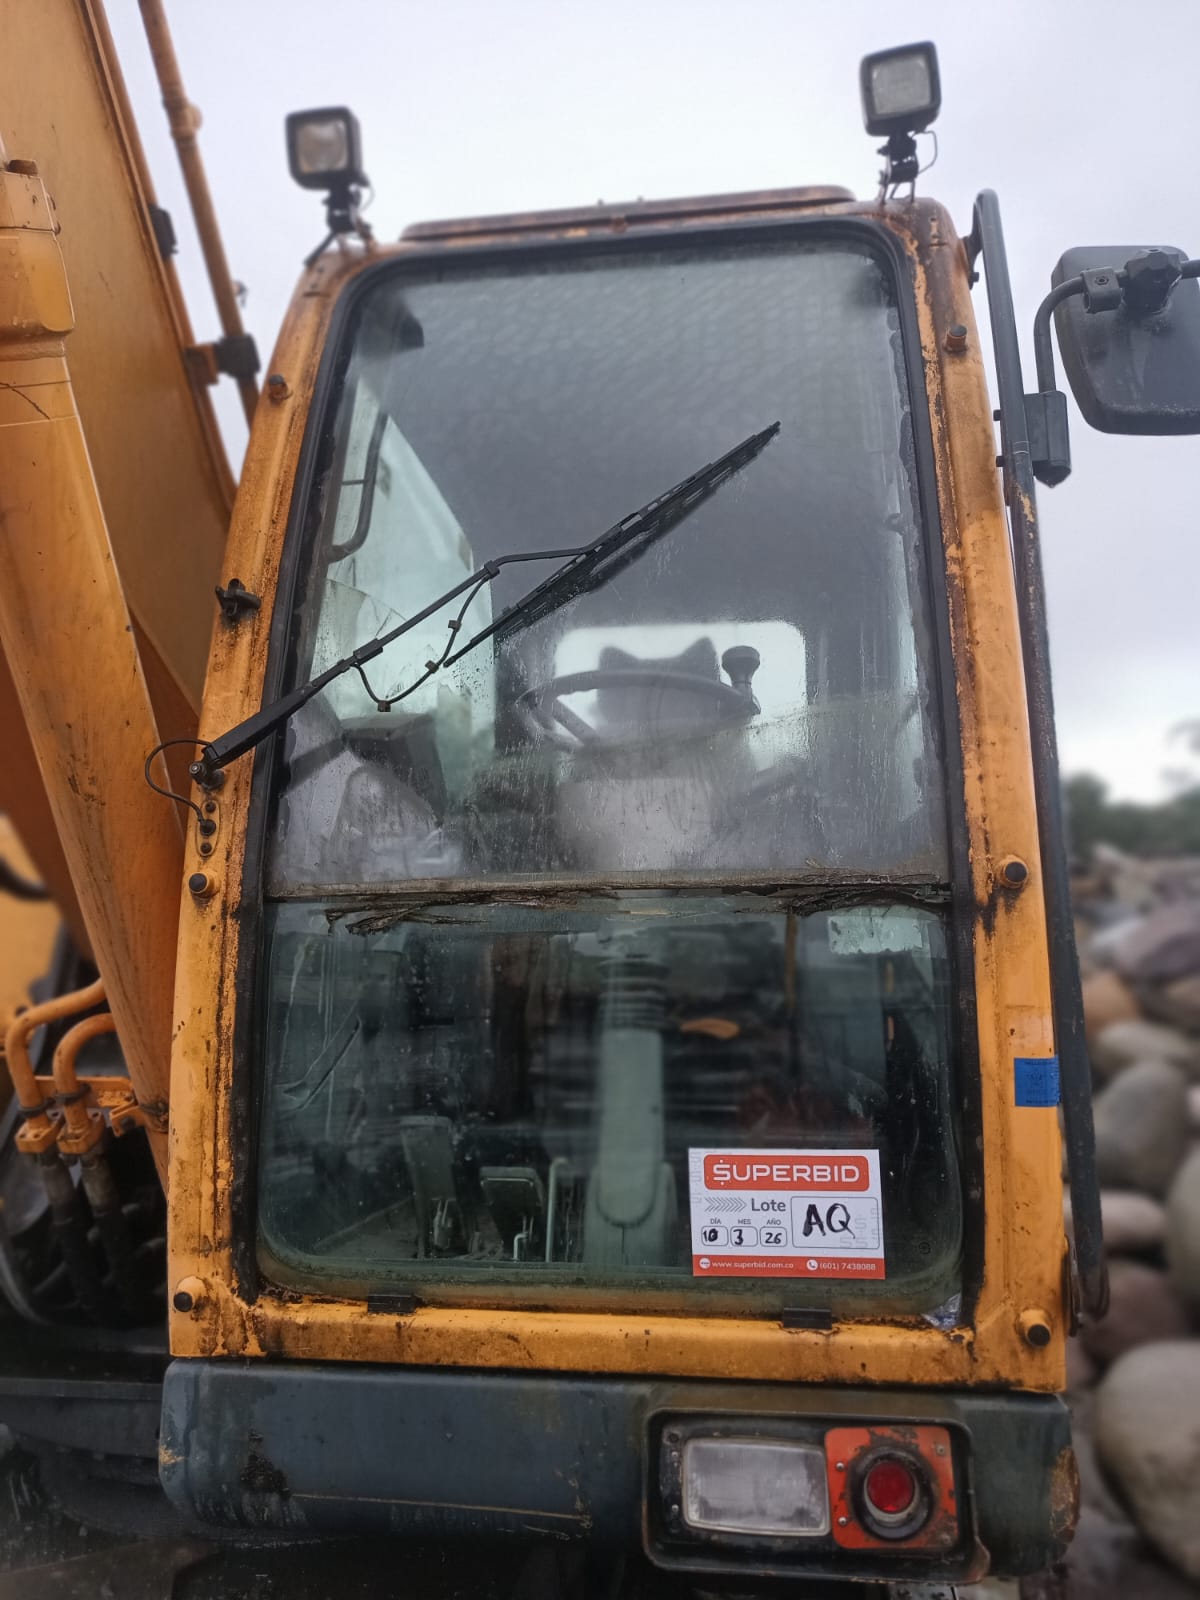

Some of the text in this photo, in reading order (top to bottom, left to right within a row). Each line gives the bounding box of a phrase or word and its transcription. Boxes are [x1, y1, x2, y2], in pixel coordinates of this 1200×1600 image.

[713, 1159, 860, 1184] SUPERBID
[751, 1198, 786, 1212] Lote
[766, 1217, 782, 1226] AÑO
[802, 1203, 856, 1239] AQ
[733, 1229, 744, 1246] 3
[765, 1232, 782, 1244] 26
[712, 1261, 794, 1269] www.superbid.com.co
